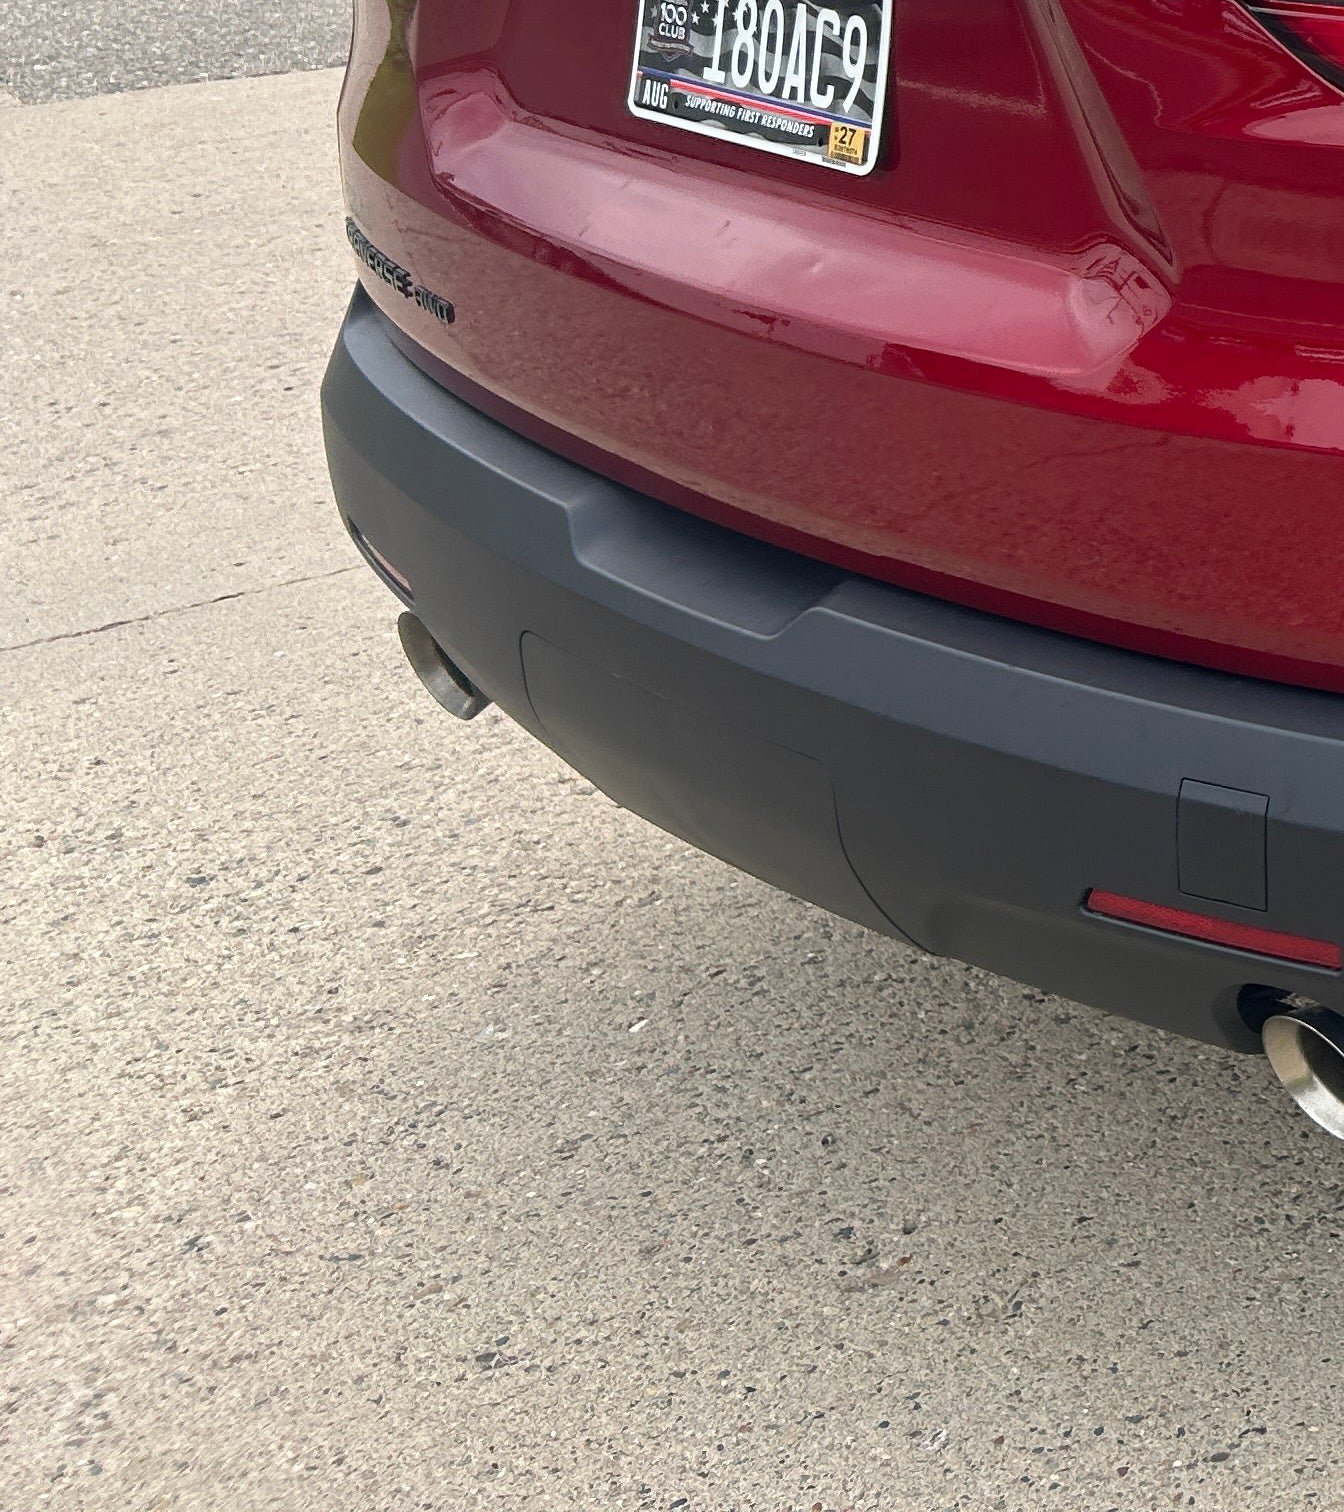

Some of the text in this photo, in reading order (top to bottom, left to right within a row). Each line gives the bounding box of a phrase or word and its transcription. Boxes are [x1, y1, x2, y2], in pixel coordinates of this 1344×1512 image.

[660, 2, 687, 26] 100
[658, 22, 686, 40] CLUB
[642, 79, 669, 110] AUG
[685, 94, 736, 118] SUPPORTING
[736, 107, 761, 125] FIRST
[760, 114, 815, 138] RESPONDERS
[838, 126, 857, 147] 27
